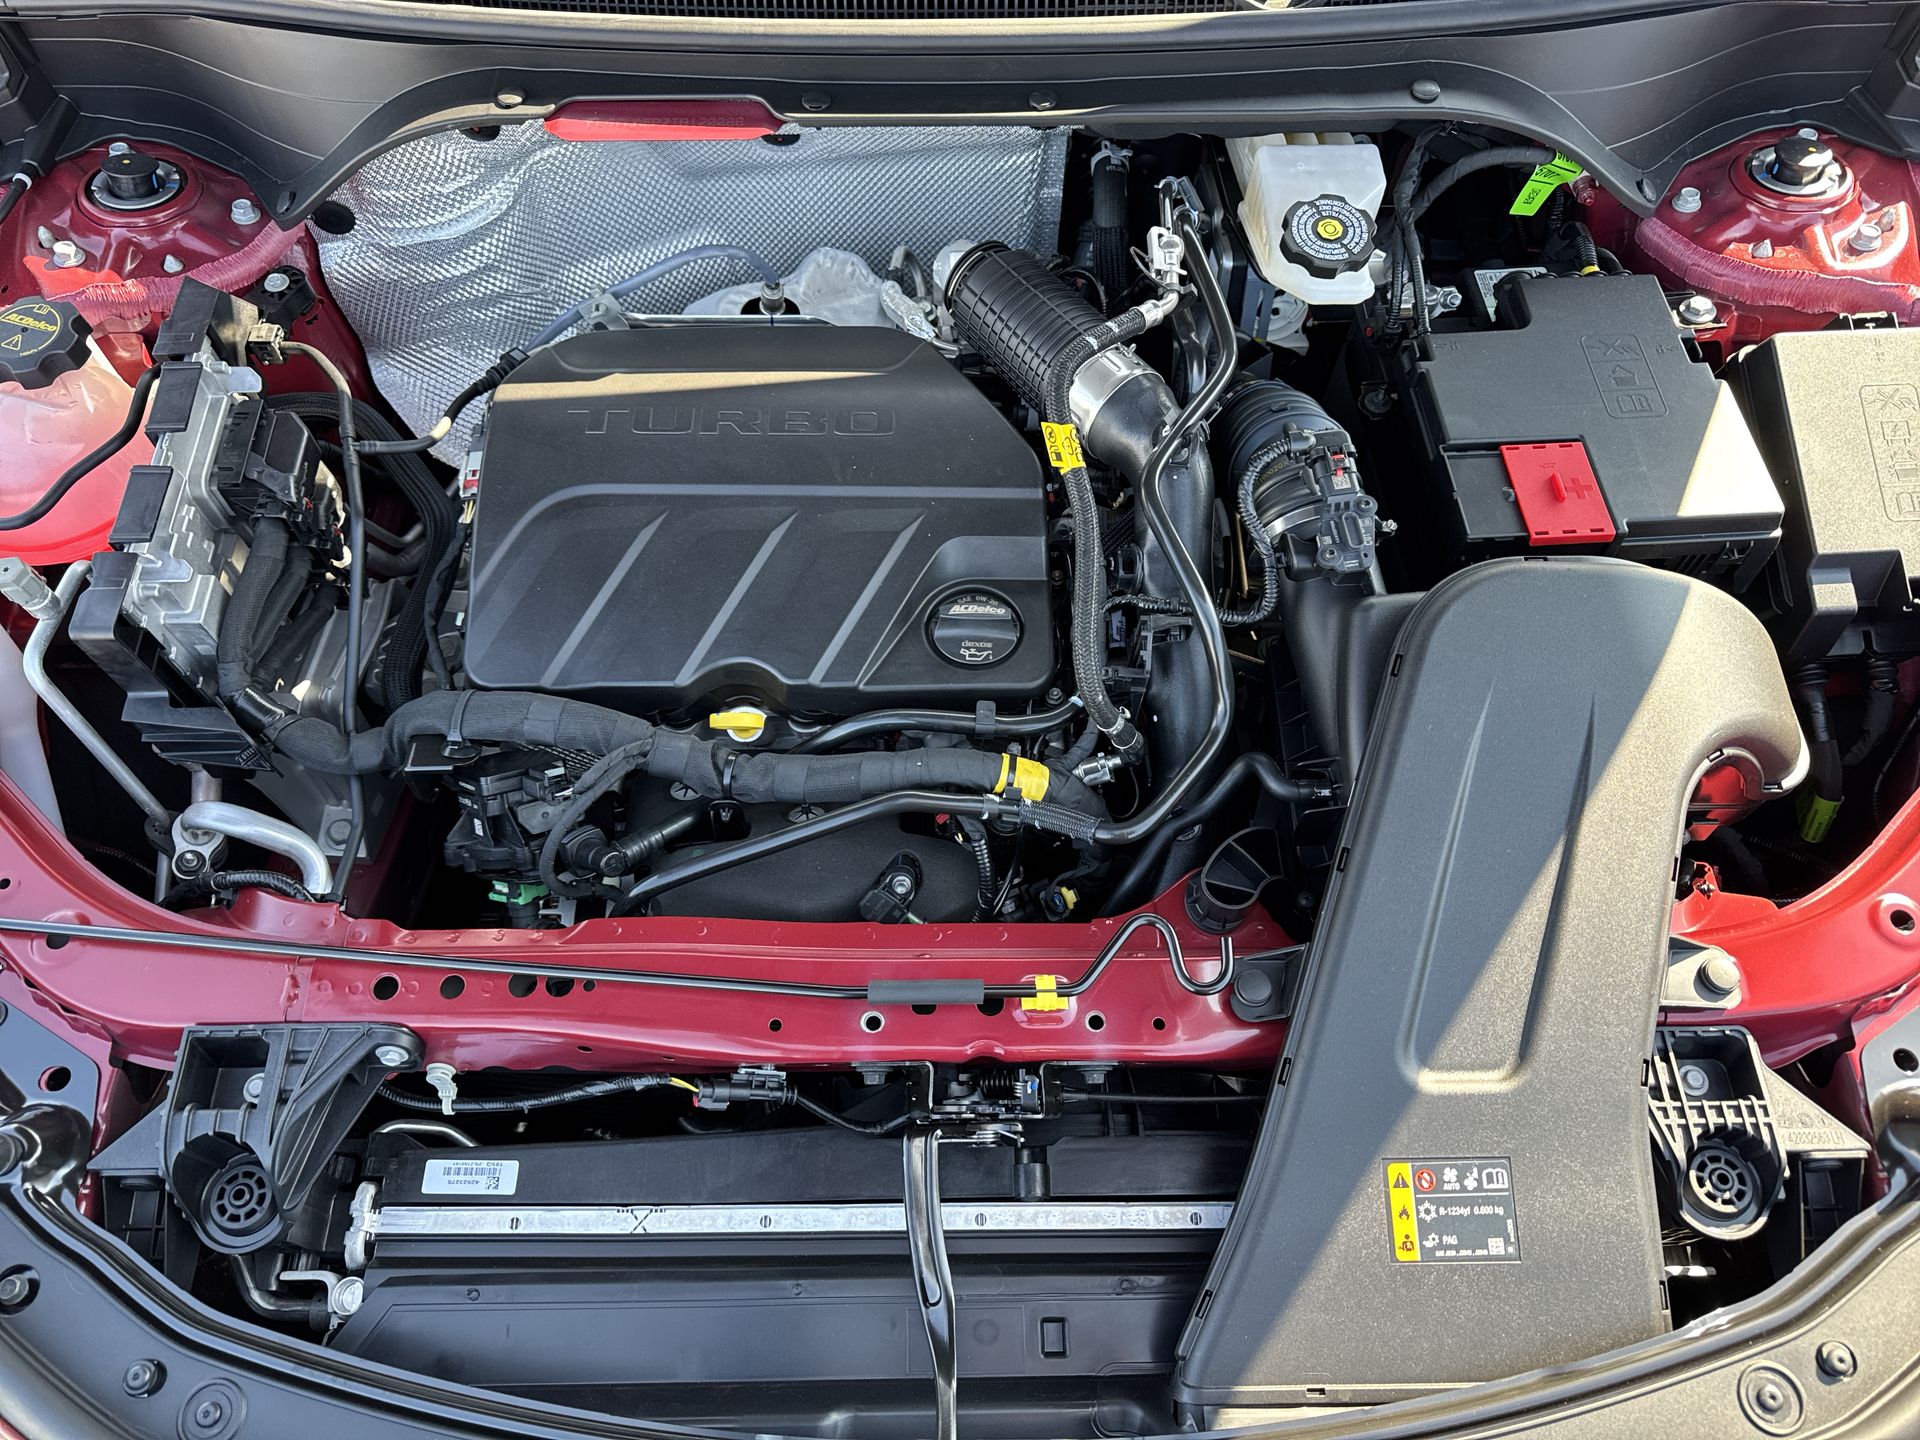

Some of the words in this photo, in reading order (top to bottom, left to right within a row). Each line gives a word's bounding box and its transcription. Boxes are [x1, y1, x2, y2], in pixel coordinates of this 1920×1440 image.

[4, 313, 57, 332] ACDelco
[567, 407, 896, 436] TURBO
[957, 596, 972, 604] SAE
[948, 604, 1006, 615] ACDelco
[961, 640, 993, 648] dexos
[1443, 1182, 1460, 1190] AUTO
[1439, 1206, 1471, 1217] R-1234yf
[1494, 1205, 1504, 1216] kg
[1442, 1235, 1458, 1245] PAG
